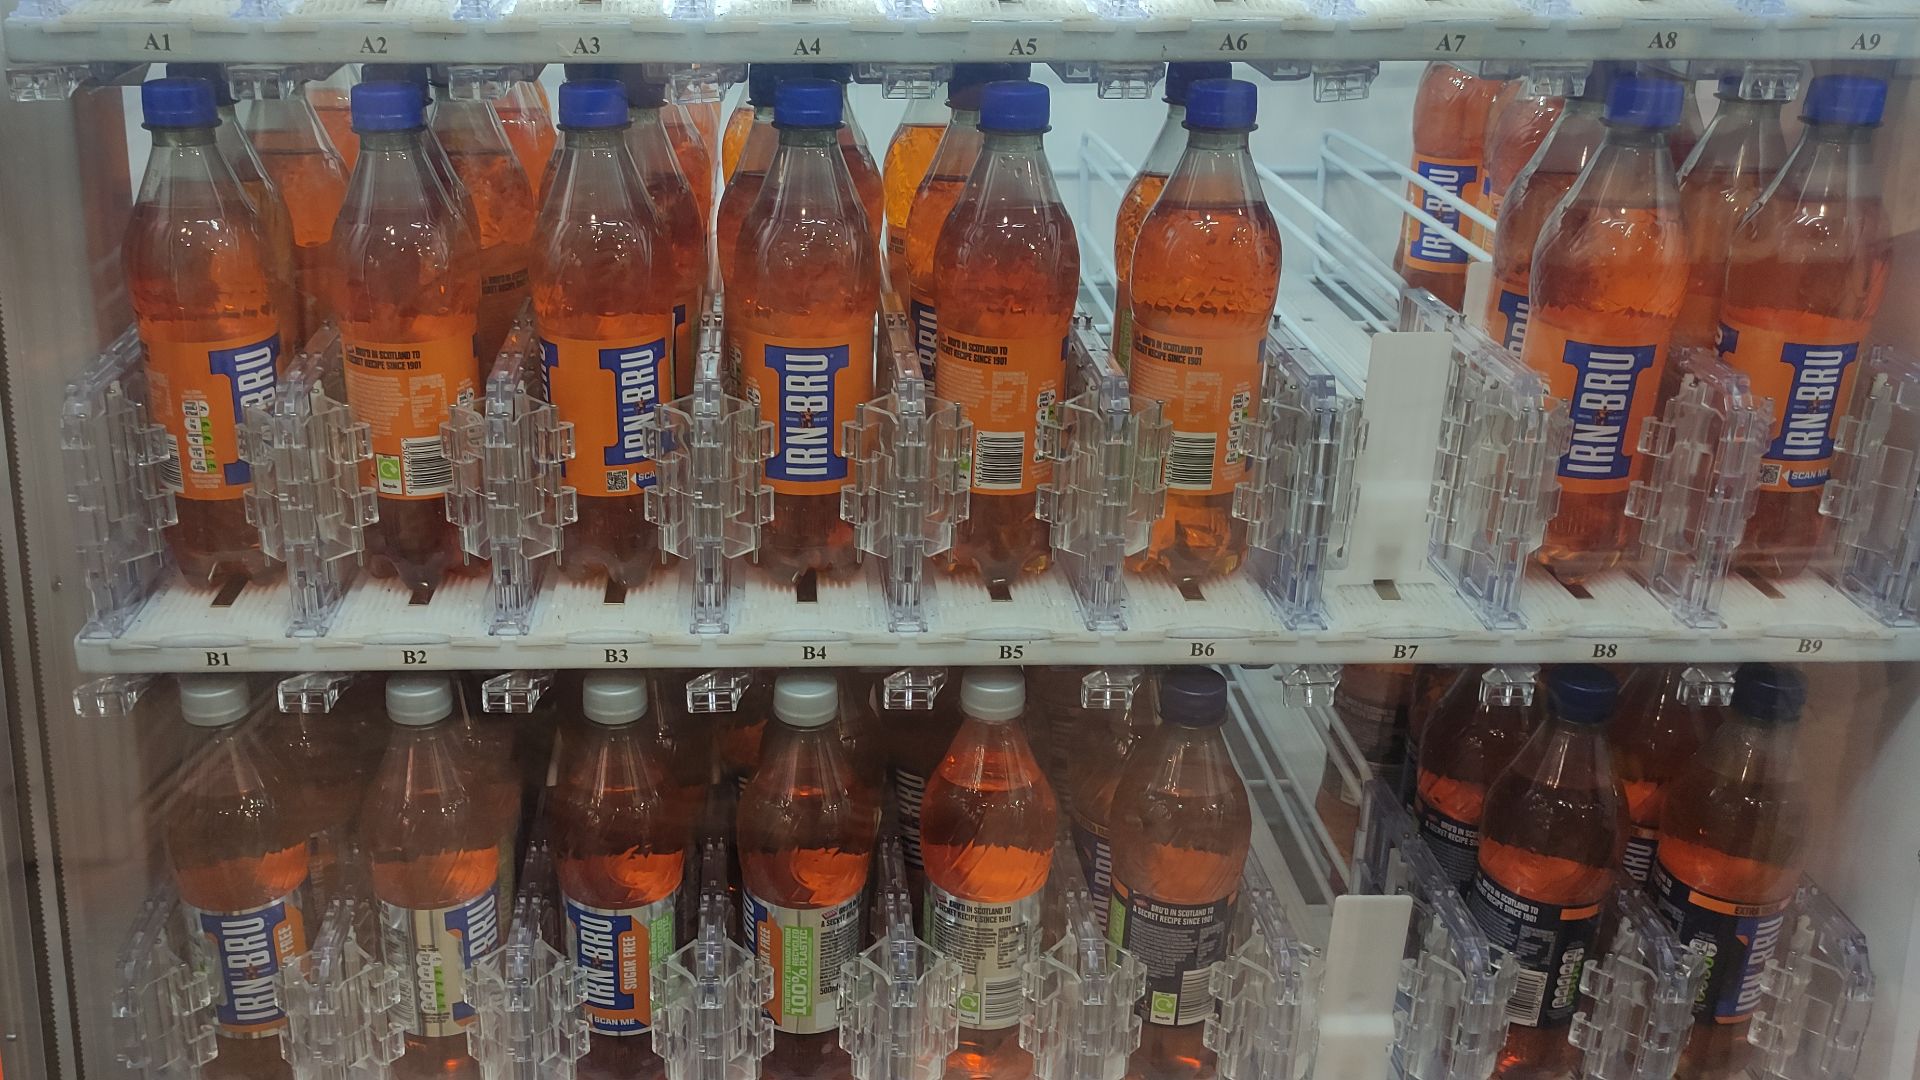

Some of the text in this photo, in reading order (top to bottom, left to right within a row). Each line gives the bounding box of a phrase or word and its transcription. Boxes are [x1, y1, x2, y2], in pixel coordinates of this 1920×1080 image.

[144, 33, 171, 52] A1
[360, 36, 388, 54] A2
[572, 37, 601, 54] A3
[793, 38, 821, 56] A4
[1009, 38, 1037, 56] A5
[1220, 33, 1249, 51] A6
[1436, 34, 1467, 52] A7
[1648, 31, 1678, 49] A8
[1850, 33, 1881, 50] A9
[412, 350, 420, 358] TO
[968, 342, 998, 355] SCOTLAND
[1000, 346, 1008, 355] TO
[1194, 346, 1203, 356] TO
[406, 361, 422, 370] 1901
[973, 354, 992, 365] SINCE
[993, 356, 1008, 366] 1901
[235, 346, 276, 411] BRU
[620, 349, 655, 404] BRU
[785, 354, 828, 412] BRU
[1782, 350, 1843, 456] IRN BRU
[1566, 352, 1635, 473] IRN BRU
[785, 426, 828, 475] IRN
[638, 470, 657, 481] SCA
[1792, 470, 1816, 480] SCAN
[801, 645, 827, 660] B4
[999, 645, 1024, 660] B5
[1189, 642, 1215, 657] B6
[1392, 644, 1419, 659] B7
[1591, 643, 1618, 658] B8
[1796, 638, 1823, 653] B9
[205, 651, 230, 667] B1
[401, 649, 428, 665] B2
[604, 648, 629, 664] B3
[966, 904, 973, 913] IN
[974, 906, 1003, 915] SCOTLAND
[1004, 906, 1012, 914] TO
[1494, 890, 1501, 898] IN
[1501, 892, 1530, 912] SCOTLAND
[1530, 906, 1539, 915] TO
[1735, 905, 1760, 915] EXTRA
[957, 912, 978, 922] RECIPE
[979, 915, 998, 924] SINCE
[1132, 904, 1136, 912] A
[1160, 915, 1182, 925] RECIPE
[1182, 917, 1201, 925] SINCE
[1202, 915, 1214, 924] 1901
[1170, 908, 1177, 916] IN
[1178, 907, 1207, 918] SCOTLAND
[1208, 906, 1214, 915] TO
[1504, 905, 1522, 918] SINCE
[1522, 914, 1537, 922] 1901
[466, 894, 498, 958] BRU
[760, 925, 771, 951] FREE
[1748, 916, 1784, 965] BRU
[800, 929, 808, 967] PLASTIC
[221, 916, 279, 1020] IRN BRU
[580, 914, 615, 1006] IRN BRU
[622, 935, 638, 990] SUGAR FREE
[791, 928, 808, 1015] 100% RECYCLED
[594, 1016, 636, 1026] SCAN ME
